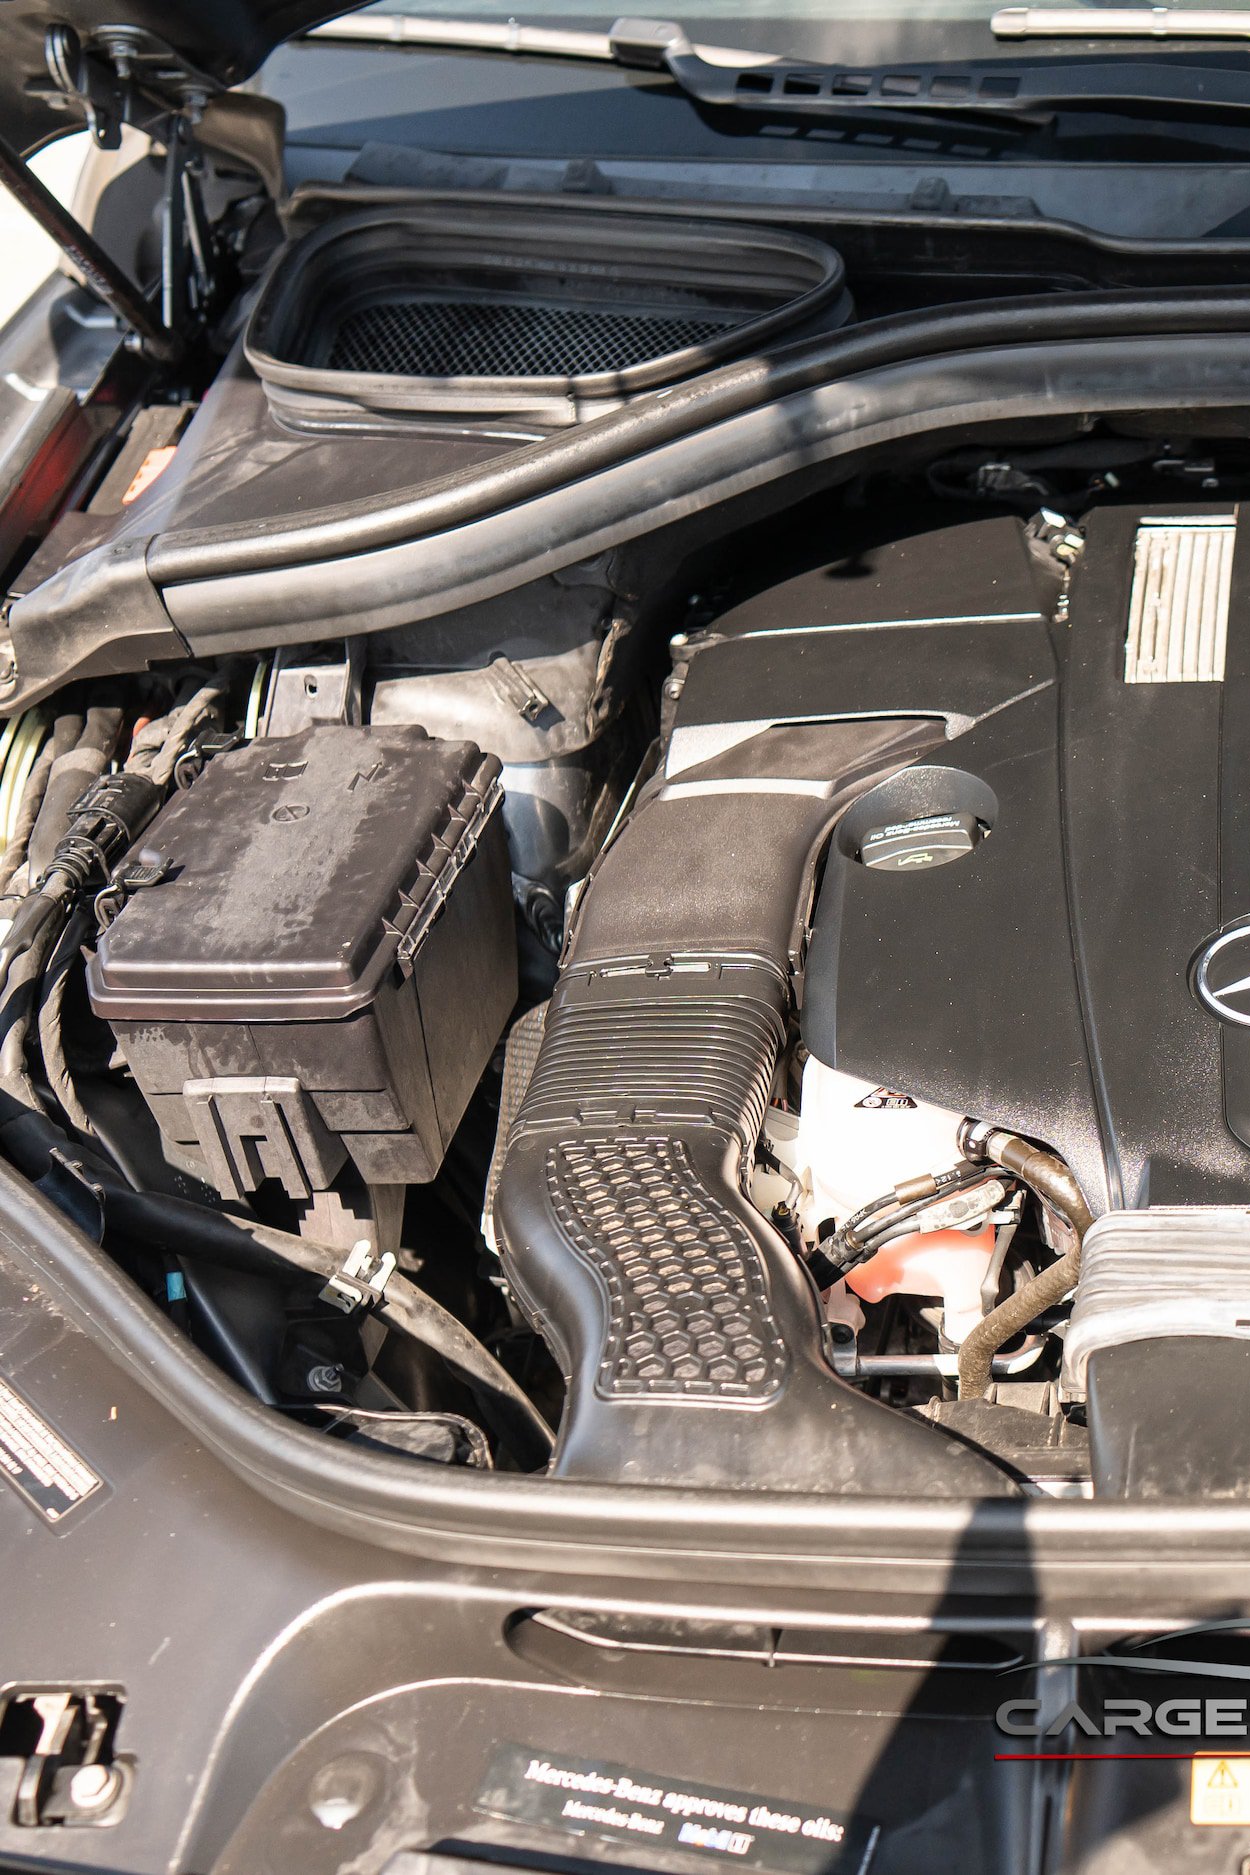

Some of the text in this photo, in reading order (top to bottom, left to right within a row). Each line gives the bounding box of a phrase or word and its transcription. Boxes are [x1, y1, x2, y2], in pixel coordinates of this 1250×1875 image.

[524, 1759, 664, 1806] Mercedes-Benz
[662, 1792, 748, 1823] approves
[748, 1806, 801, 1834] these
[561, 1799, 665, 1835] Mercedes-Benz
